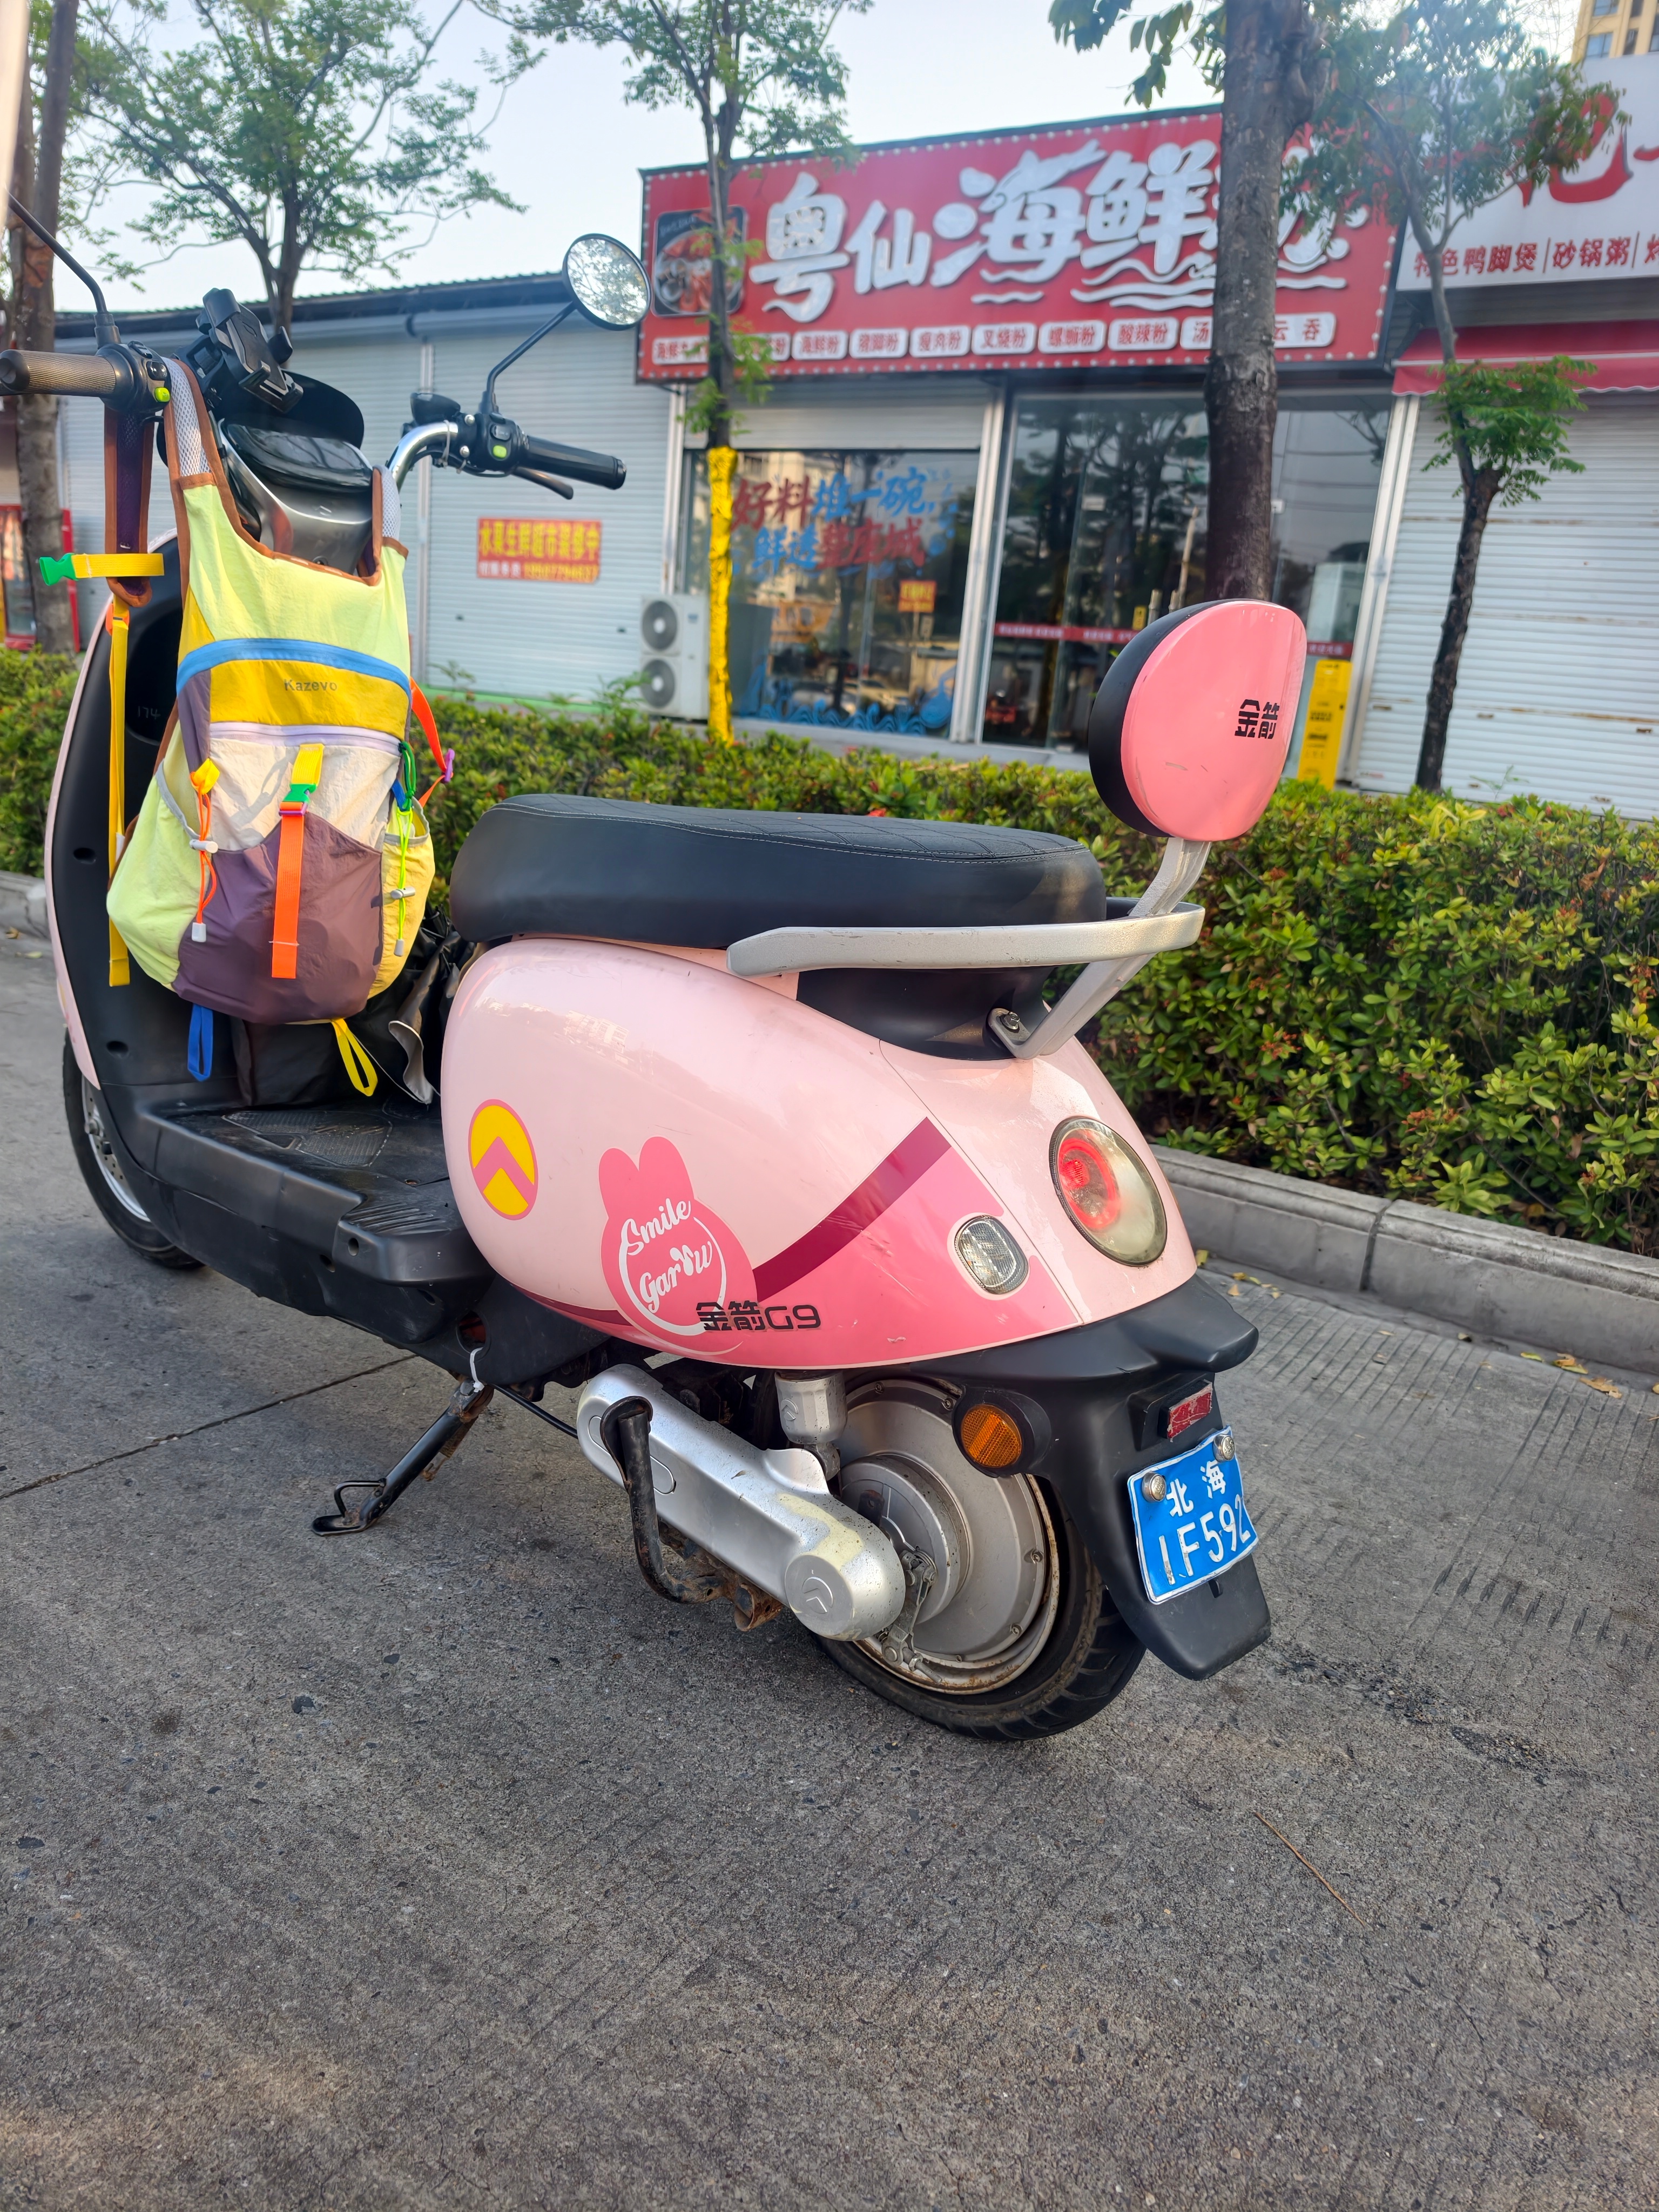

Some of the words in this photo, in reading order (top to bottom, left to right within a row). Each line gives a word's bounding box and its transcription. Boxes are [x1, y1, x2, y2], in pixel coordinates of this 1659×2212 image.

[1553, 236, 1631, 268] 砂锅粥
[801, 333, 840, 354] 海鲜粉
[920, 330, 961, 351] 瘦肉粉
[982, 328, 1026, 349] 叉烧粉
[1119, 322, 1167, 345] 酸辣粉
[284, 679, 337, 691] Kazevo
[1235, 699, 1280, 739] 金箭
[621, 1198, 691, 1256] Smile
[1166, 1459, 1226, 1517] 北海
